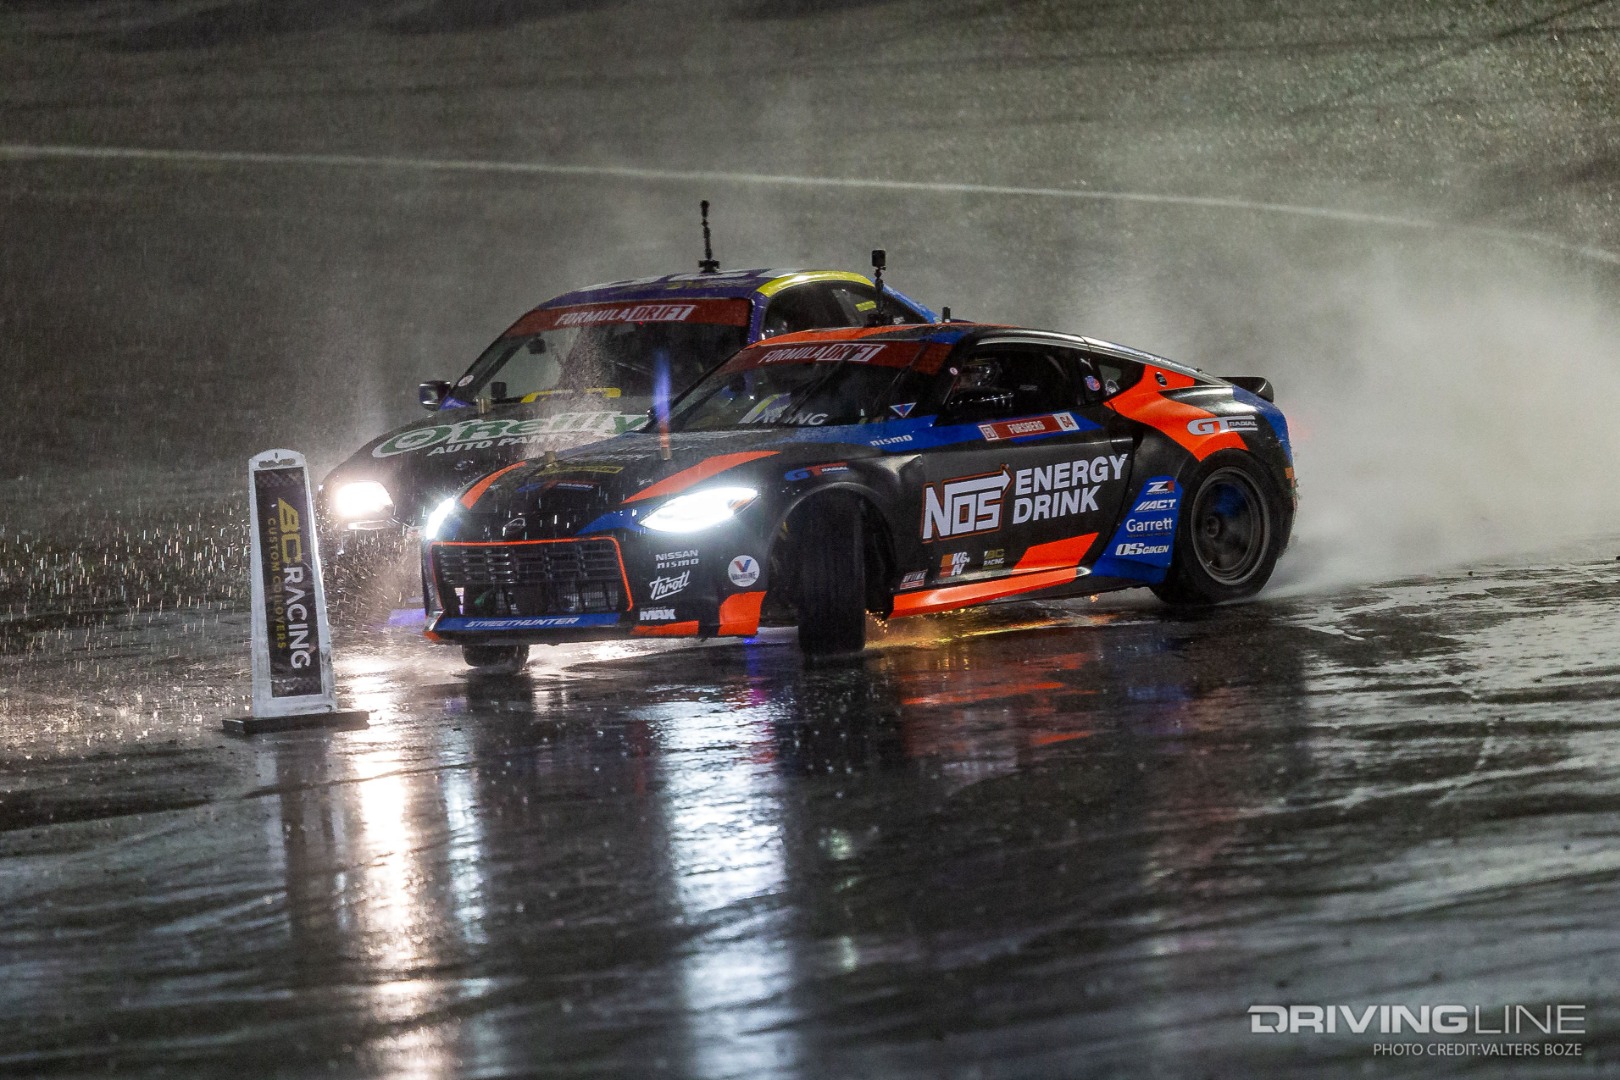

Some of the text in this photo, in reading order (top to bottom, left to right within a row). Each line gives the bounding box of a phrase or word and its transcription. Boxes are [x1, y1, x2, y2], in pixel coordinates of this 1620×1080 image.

[427, 434, 576, 456] AUTO PARTS
[1015, 453, 1128, 496] ENERGY
[922, 469, 1012, 540] NOS
[1013, 485, 1101, 524] DRINK
[1126, 518, 1173, 532] Garrett
[655, 549, 699, 561] NISSAN
[267, 517, 287, 649] CUSTOM COILOVERS
[278, 497, 310, 669] BC RACING
[465, 617, 580, 628] STREETHUNTER
